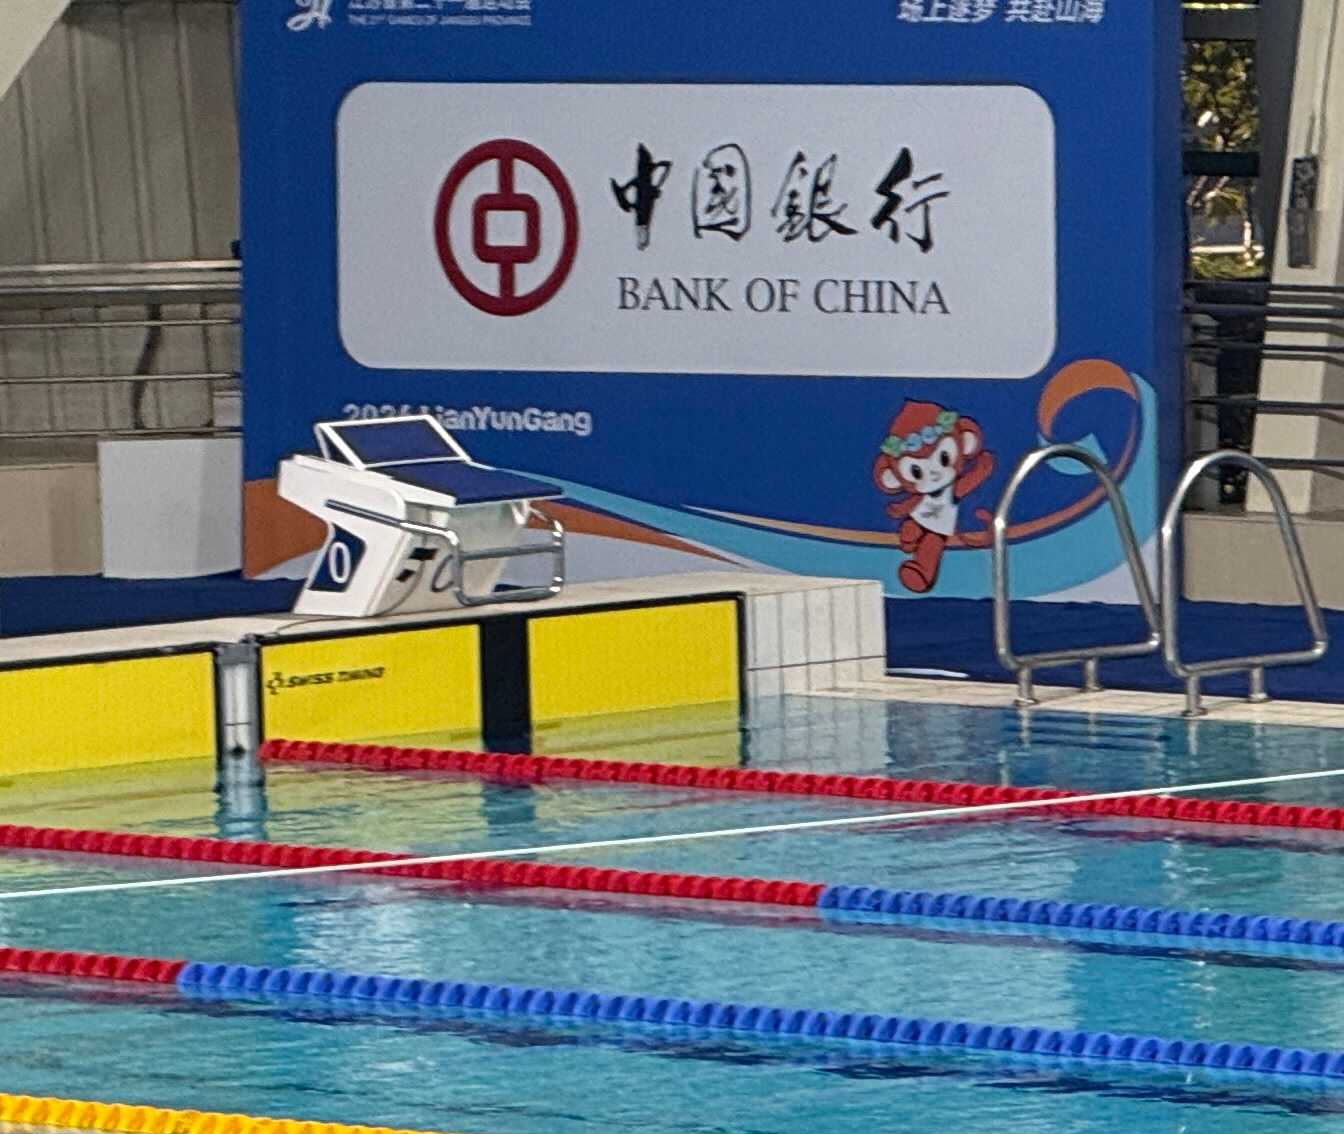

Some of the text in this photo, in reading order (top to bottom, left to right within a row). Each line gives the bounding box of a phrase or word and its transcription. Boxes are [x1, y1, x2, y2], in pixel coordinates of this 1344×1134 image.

[617, 276, 951, 315] BANK OF CHINA
[328, 541, 351, 584] 0
